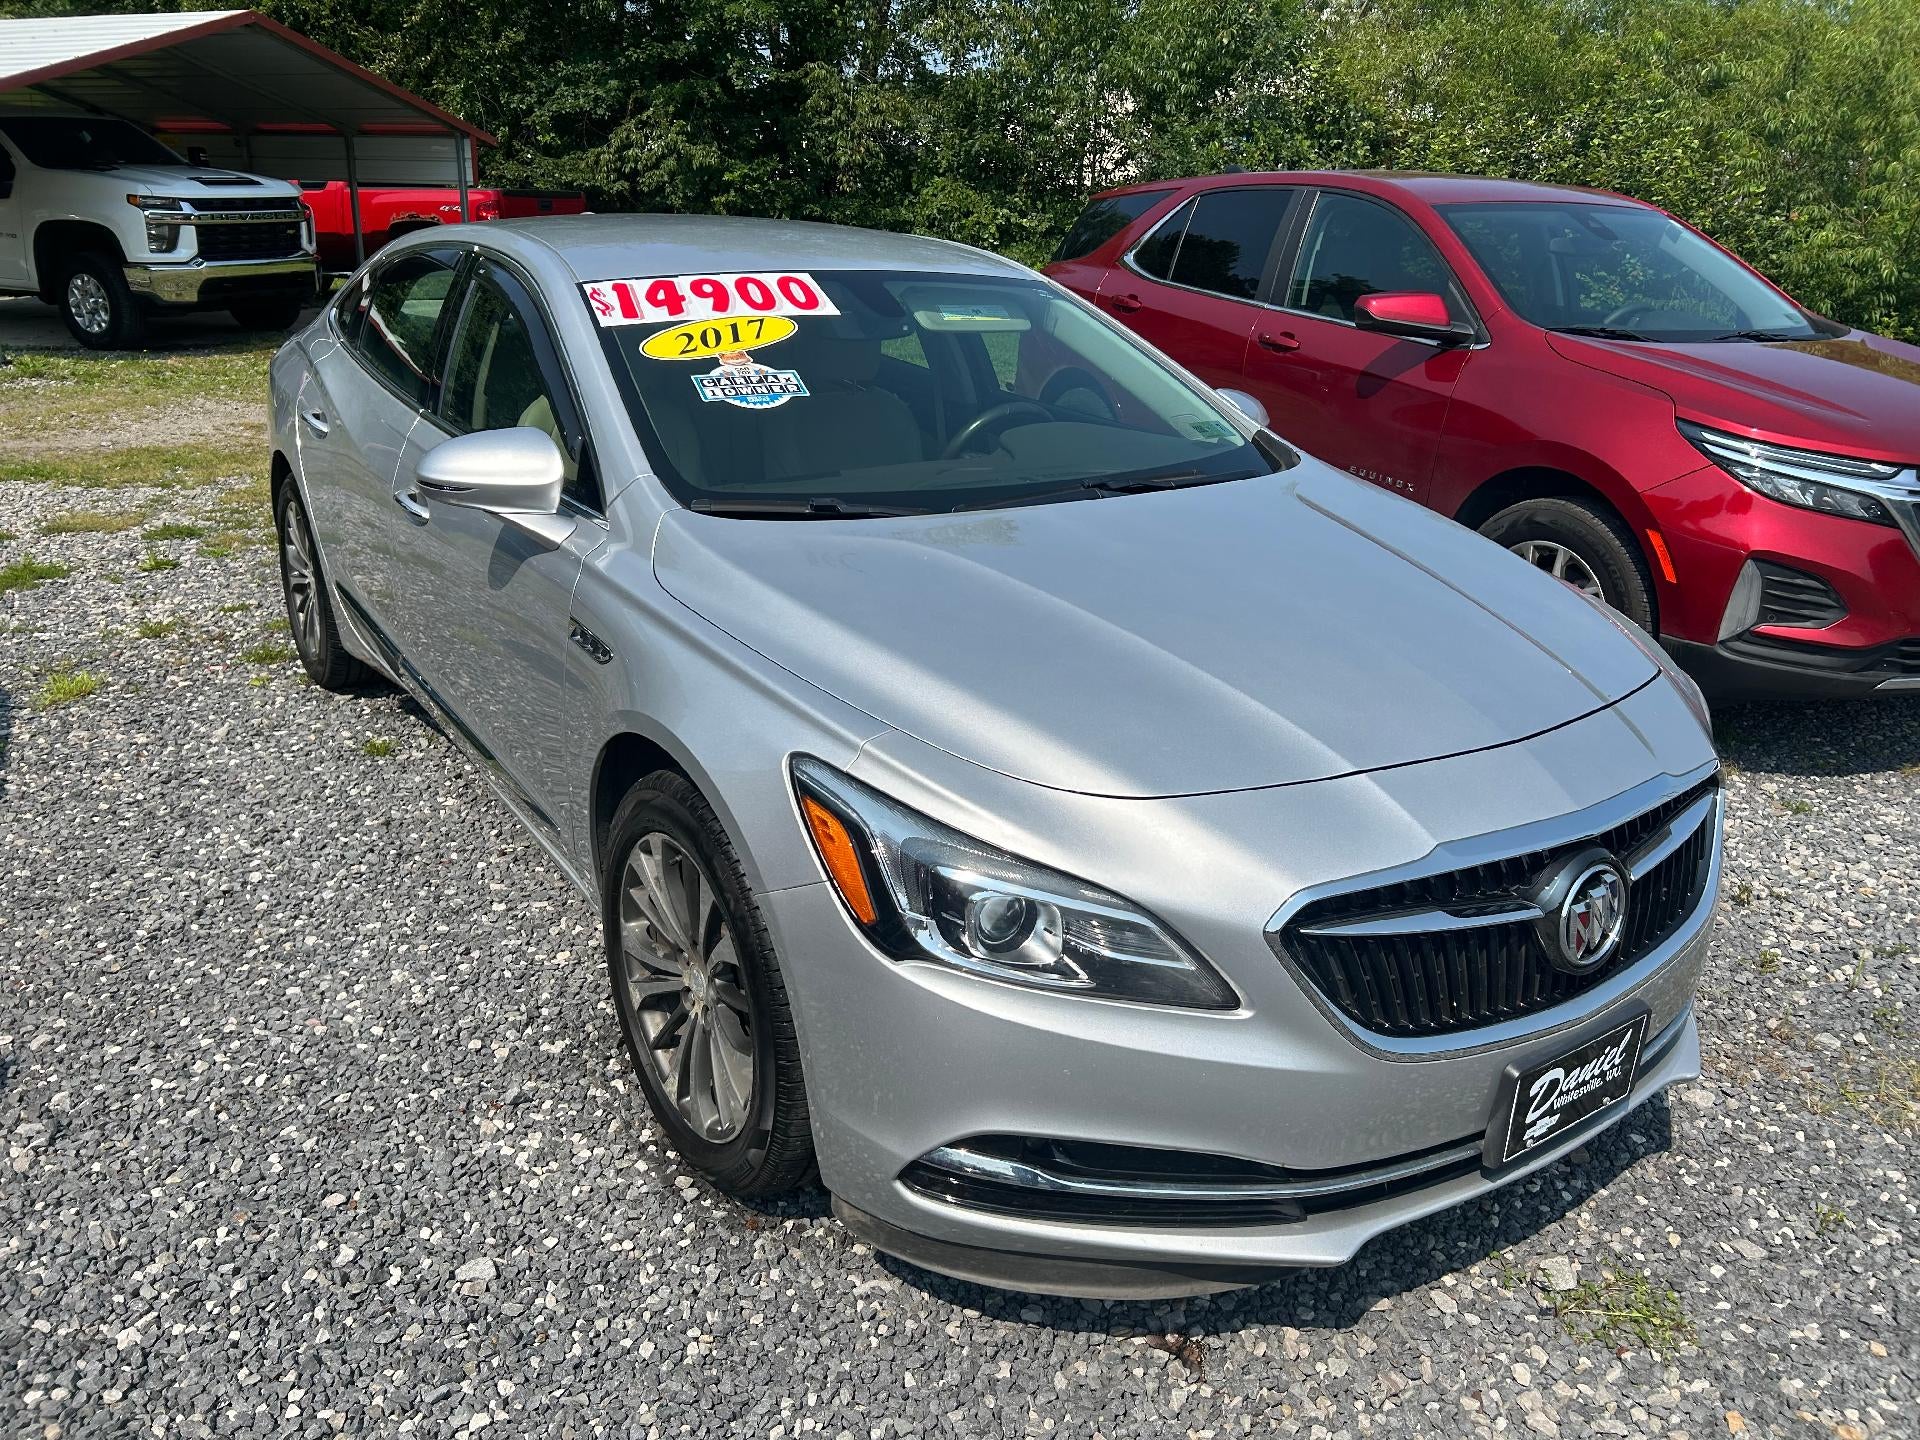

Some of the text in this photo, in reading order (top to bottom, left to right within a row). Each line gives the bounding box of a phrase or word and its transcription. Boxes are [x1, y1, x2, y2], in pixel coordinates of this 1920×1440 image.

[589, 276, 820, 319] $14900
[675, 318, 765, 355] 2017
[702, 375, 794, 387] CARFAX
[723, 383, 800, 396] OWNER
[1350, 465, 1414, 492] EQUINOX
[1525, 1028, 1633, 1124] Daniel
